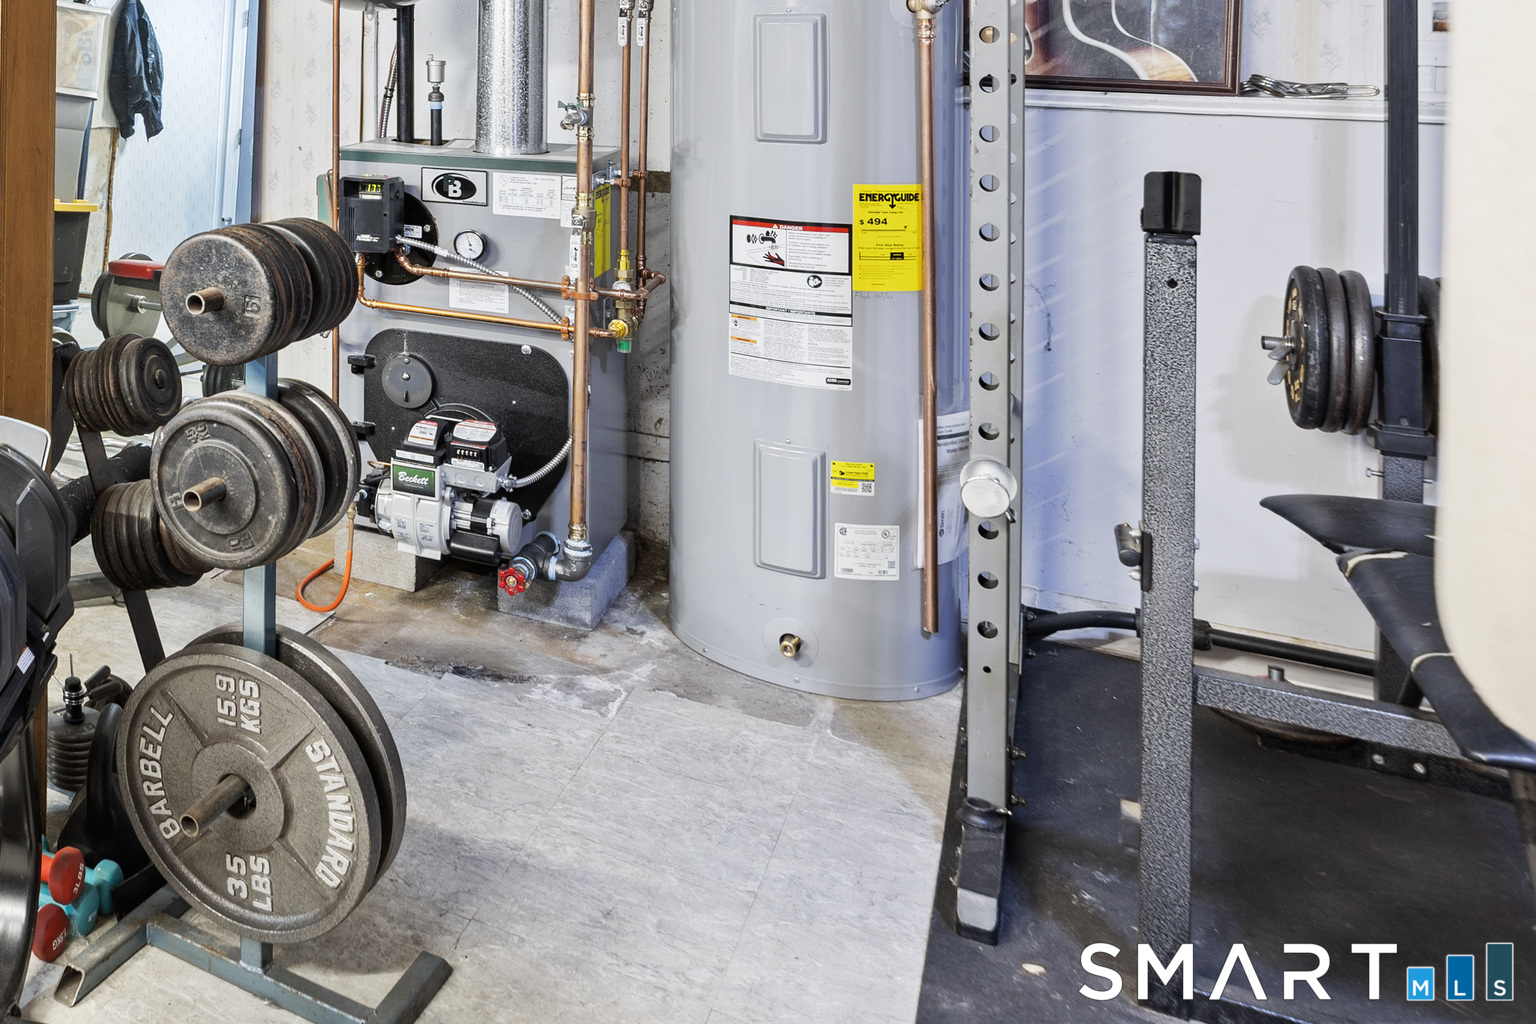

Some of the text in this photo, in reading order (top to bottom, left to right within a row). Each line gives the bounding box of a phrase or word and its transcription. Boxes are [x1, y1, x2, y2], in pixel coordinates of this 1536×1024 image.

[858, 192, 920, 203] ENERGYGUIDE
[867, 217, 888, 226] 494
[397, 470, 430, 486] Beckett
[215, 673, 237, 727] 15.9
[238, 678, 262, 734] KGS
[138, 706, 180, 840] BARBELL
[305, 738, 356, 889] STANDARD
[72, 862, 84, 895] 3LBS
[225, 853, 248, 900] 35
[250, 854, 273, 912] LBS
